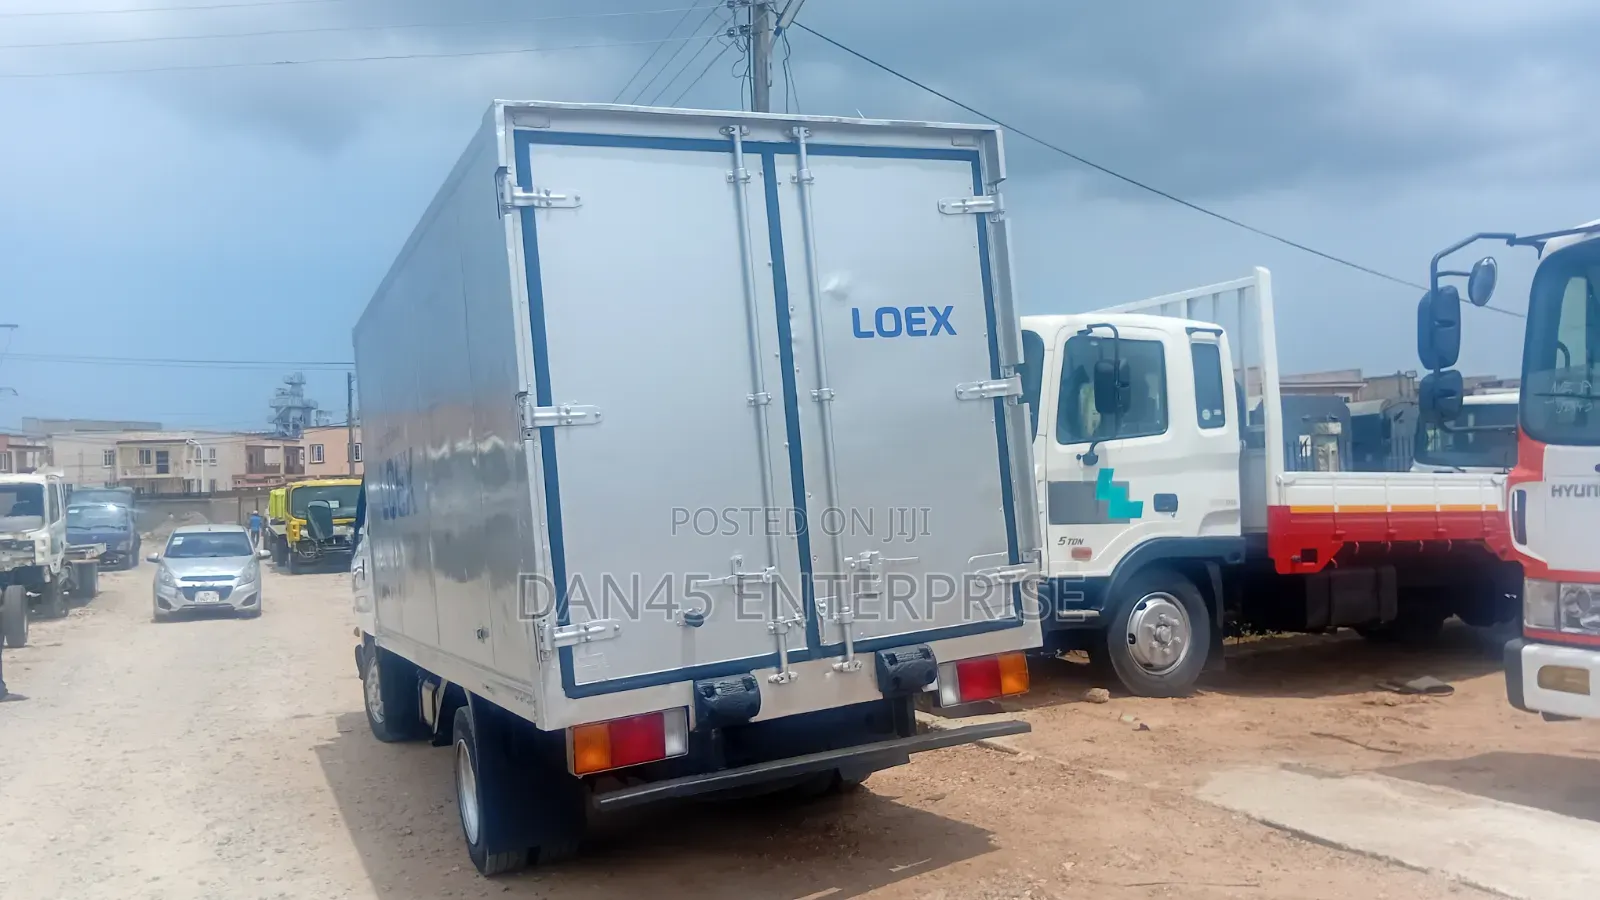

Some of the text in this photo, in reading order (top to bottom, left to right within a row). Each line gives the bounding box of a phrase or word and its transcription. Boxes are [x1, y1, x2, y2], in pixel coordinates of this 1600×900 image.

[851, 305, 957, 338] LOEX
[1551, 483, 1600, 497] HYUN
[1057, 536, 1085, 546] 5 TON
